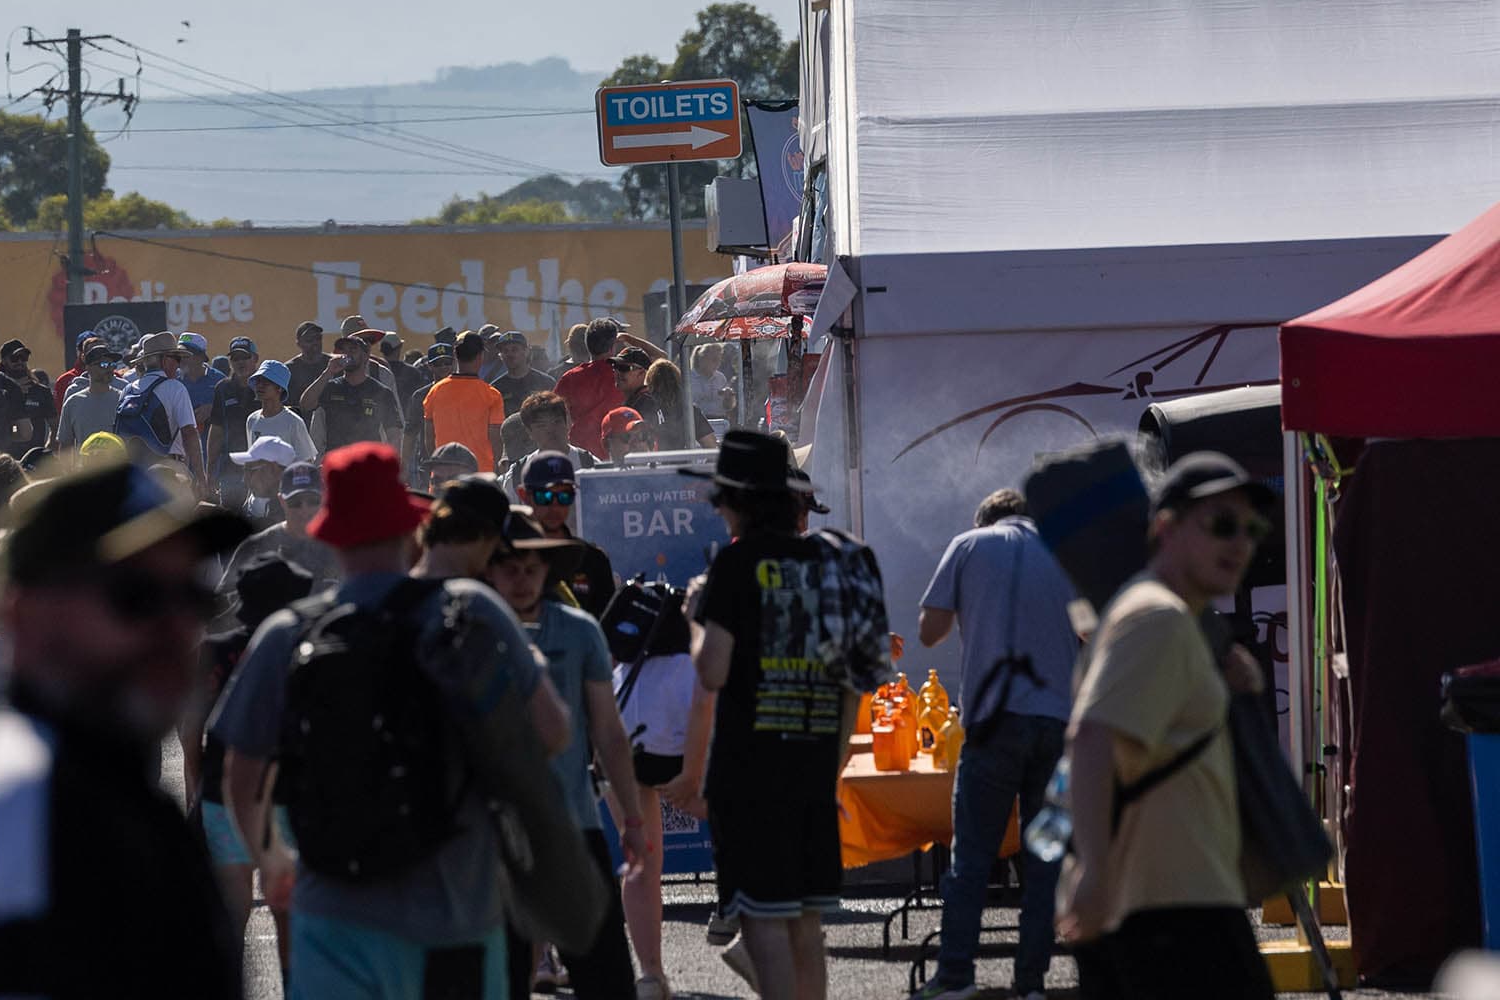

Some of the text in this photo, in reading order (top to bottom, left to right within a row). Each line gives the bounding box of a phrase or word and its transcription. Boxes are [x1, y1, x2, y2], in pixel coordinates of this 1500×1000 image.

[611, 92, 728, 120] TOILETS
[312, 258, 627, 335] Feed the
[599, 489, 697, 505] WALLOP WATER
[623, 508, 694, 538] BAR
